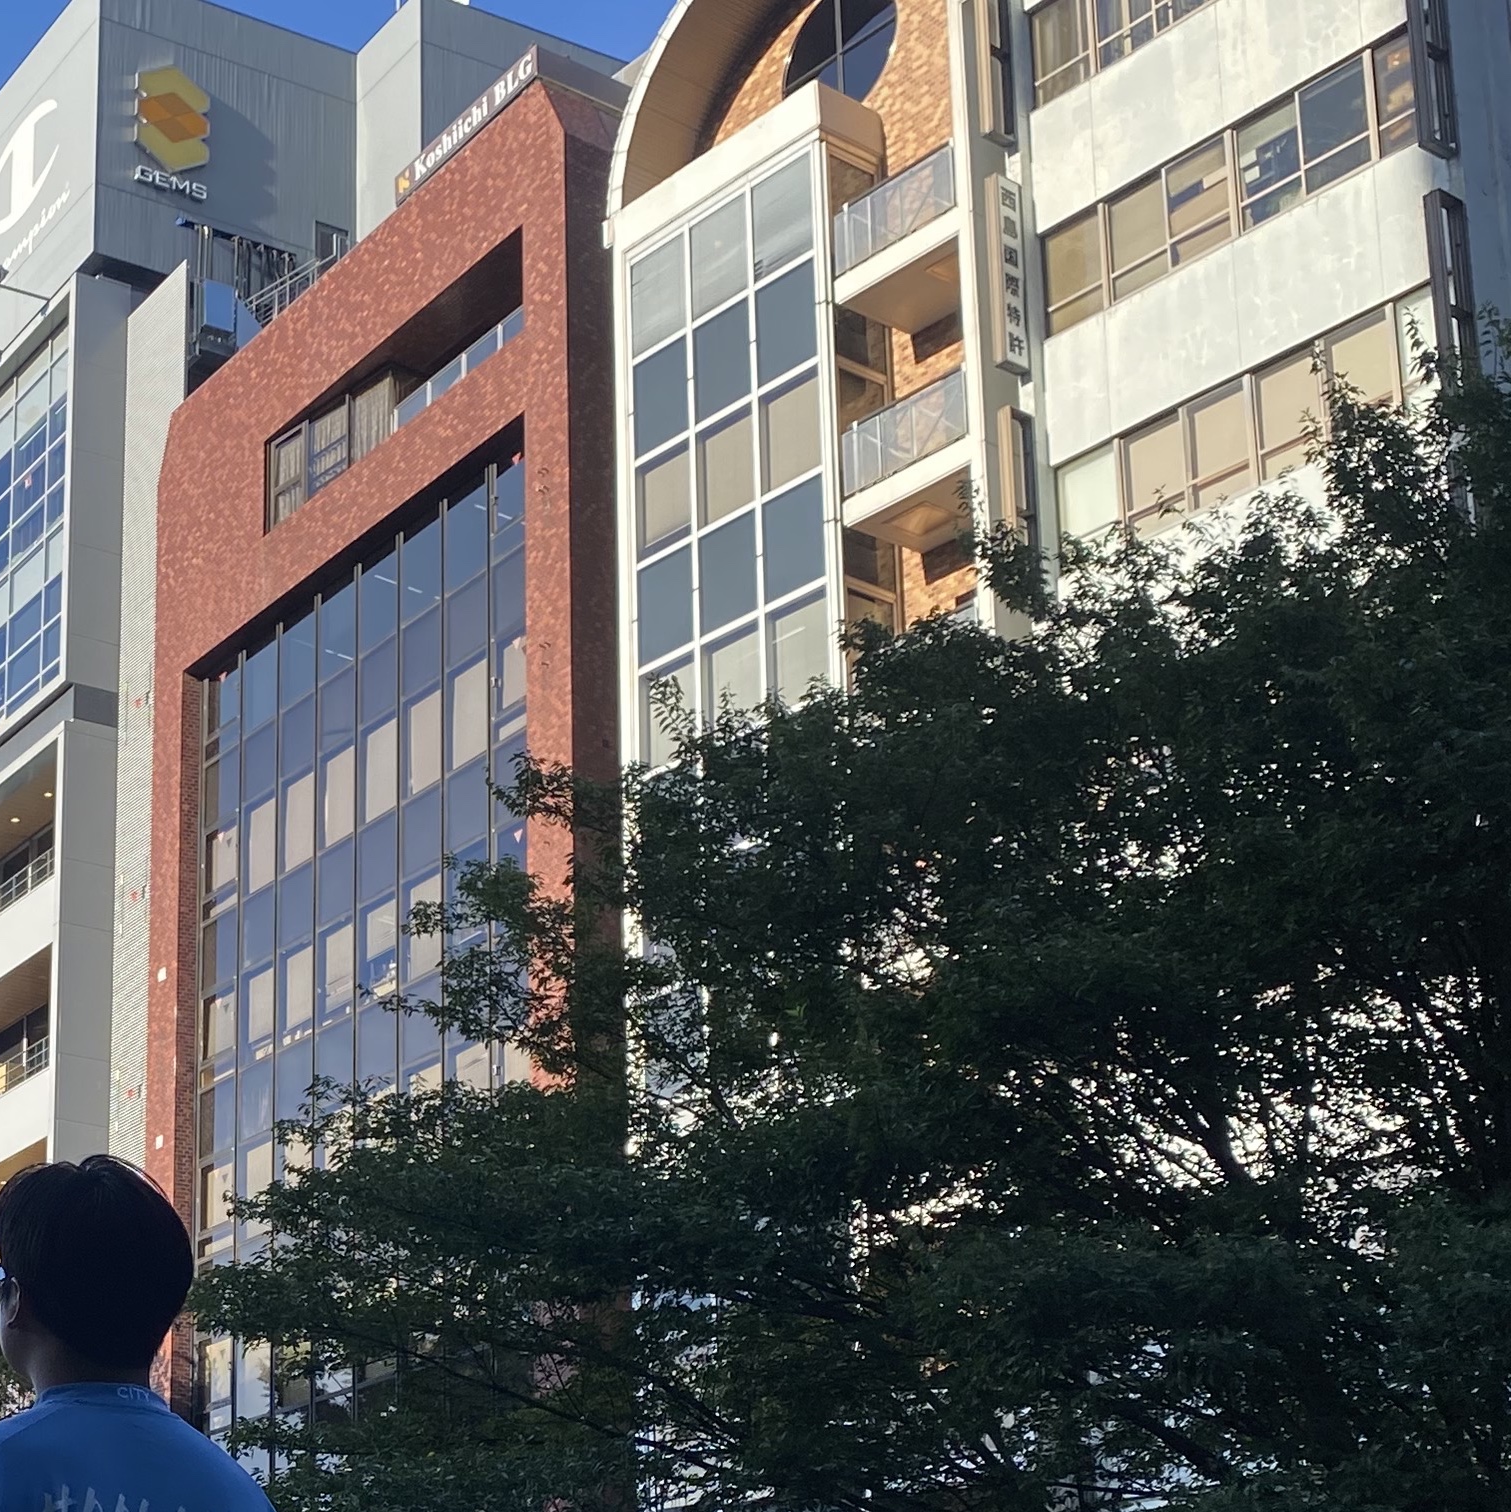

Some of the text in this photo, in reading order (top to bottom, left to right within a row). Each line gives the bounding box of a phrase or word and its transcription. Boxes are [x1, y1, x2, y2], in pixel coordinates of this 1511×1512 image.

[414, 53, 532, 181] Koshiichi BLG
[134, 165, 208, 200] GEMS
[117, 1386, 150, 1402] CITY
